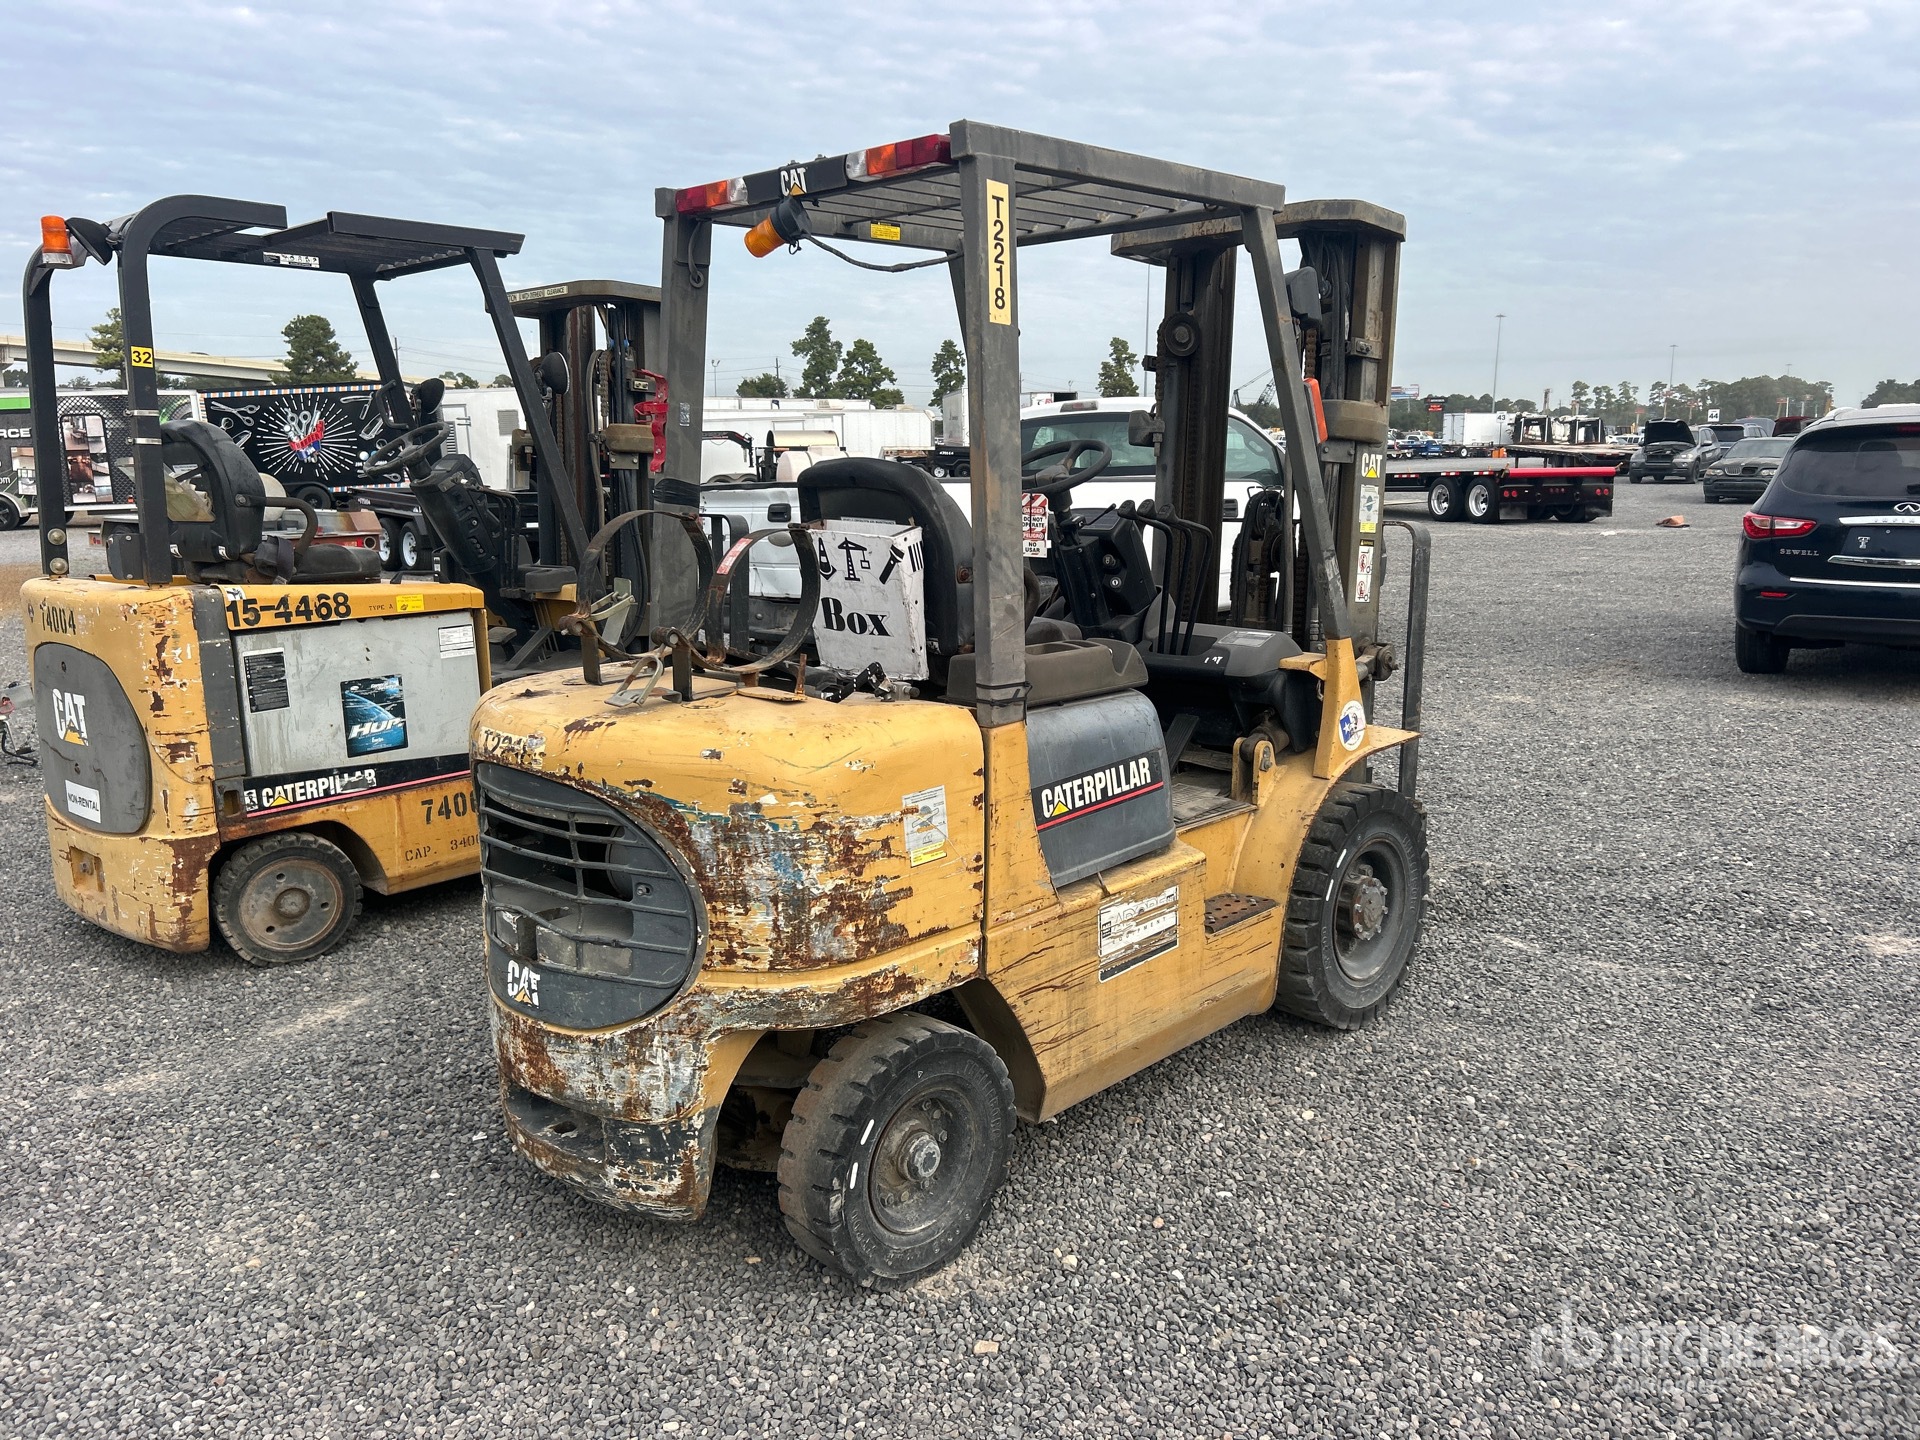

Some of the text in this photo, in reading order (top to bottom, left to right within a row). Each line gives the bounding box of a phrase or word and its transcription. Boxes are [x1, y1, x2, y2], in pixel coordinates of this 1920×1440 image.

[781, 167, 807, 197] CAT
[992, 195, 1005, 310] T2218
[547, 287, 564, 296] CLEARANCE
[132, 350, 152, 364] 32
[1362, 453, 1383, 478] CAT
[1779, 548, 1820, 557] SEWELL
[226, 592, 352, 627] 15-4468
[52, 688, 89, 747] CAT
[1041, 757, 1152, 818] CATERPILLAR
[68, 792, 100, 812] NON-RENTAL
[405, 845, 438, 862] CAP.
[507, 959, 541, 1007] CAT
